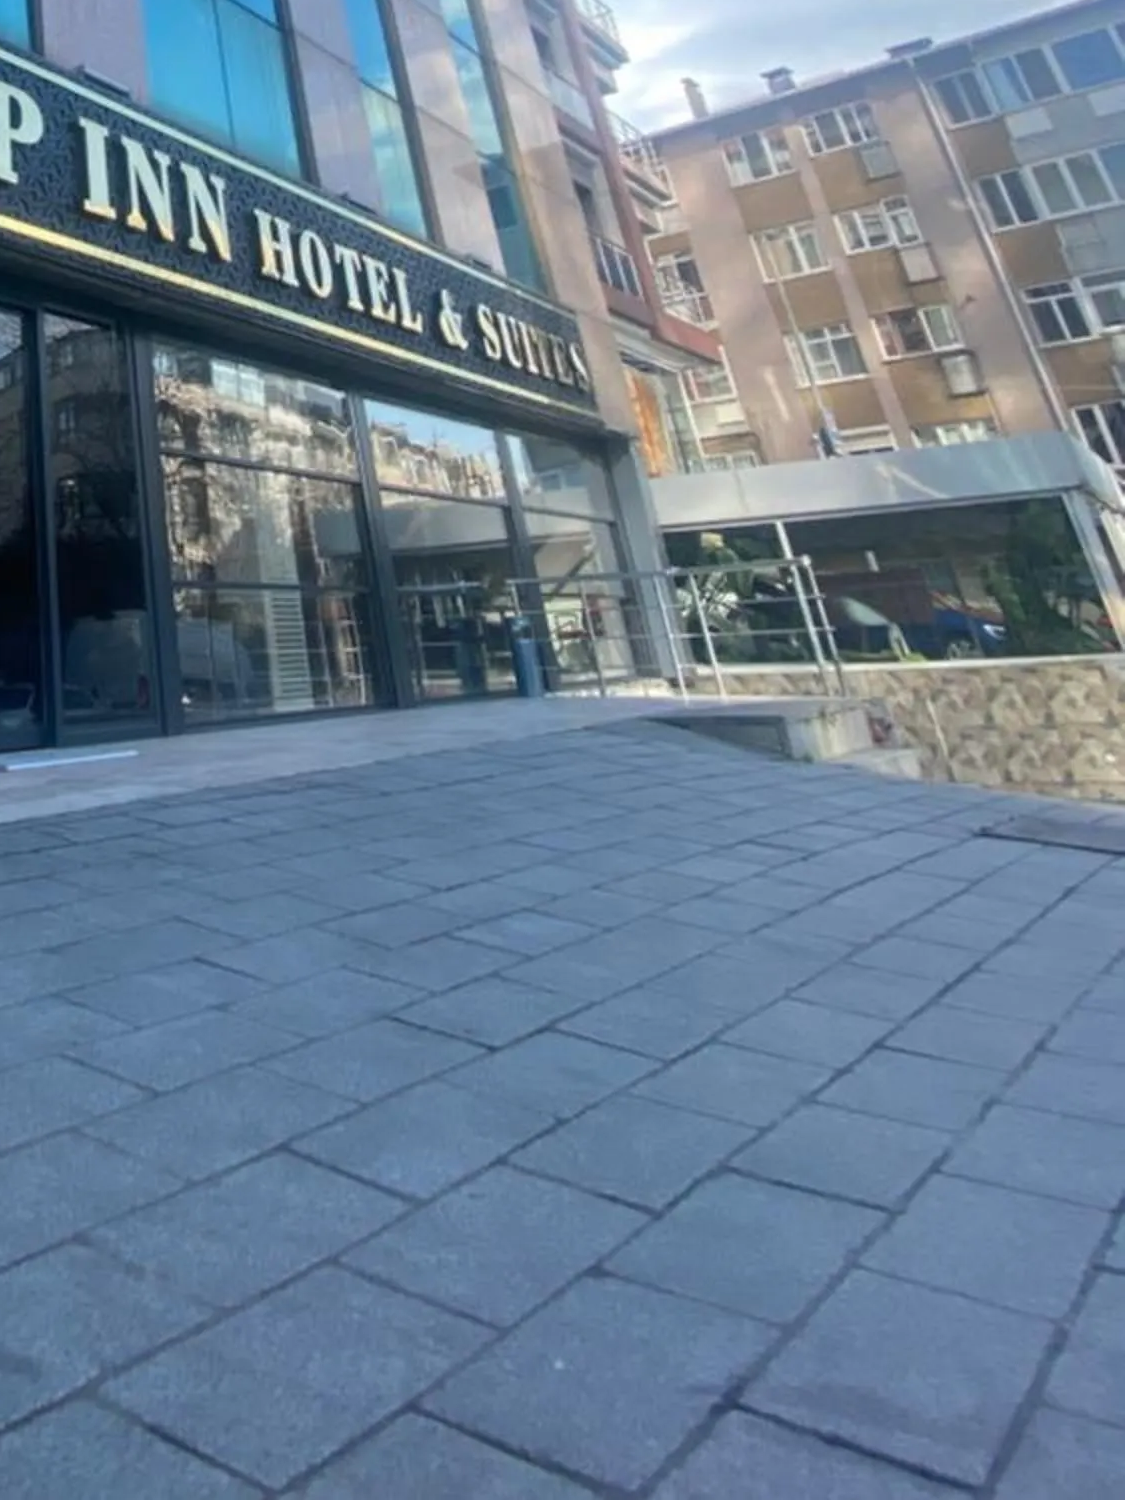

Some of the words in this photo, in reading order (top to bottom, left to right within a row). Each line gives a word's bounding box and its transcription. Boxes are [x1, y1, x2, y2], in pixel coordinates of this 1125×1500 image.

[79, 116, 233, 262] INN
[254, 207, 424, 334] HOTEL
[439, 288, 469, 350] &
[477, 303, 590, 393] SUITES
